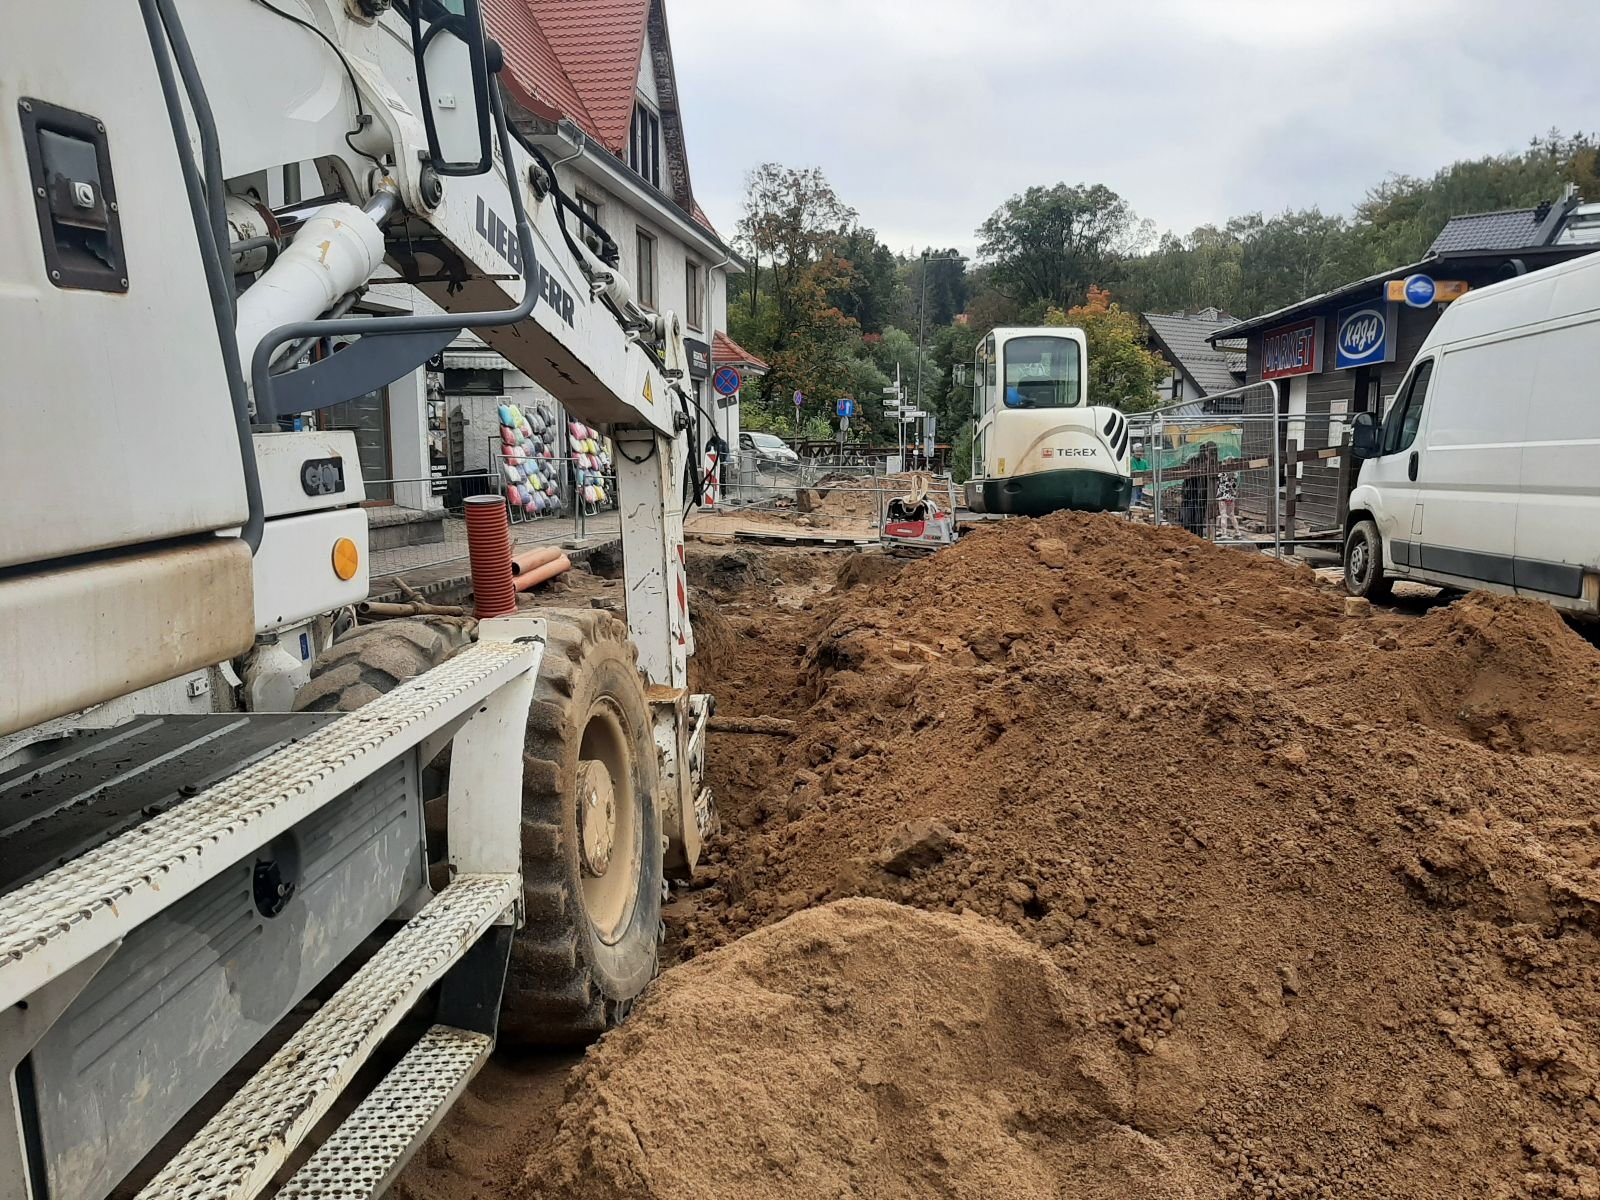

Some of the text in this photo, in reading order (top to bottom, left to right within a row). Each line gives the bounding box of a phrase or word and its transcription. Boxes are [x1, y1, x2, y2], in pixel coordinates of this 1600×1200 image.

[475, 193, 575, 330] LIEBERR
[1263, 326, 1314, 373] MARKET
[1344, 317, 1378, 351] KAJA
[1056, 448, 1097, 457] TEREX
